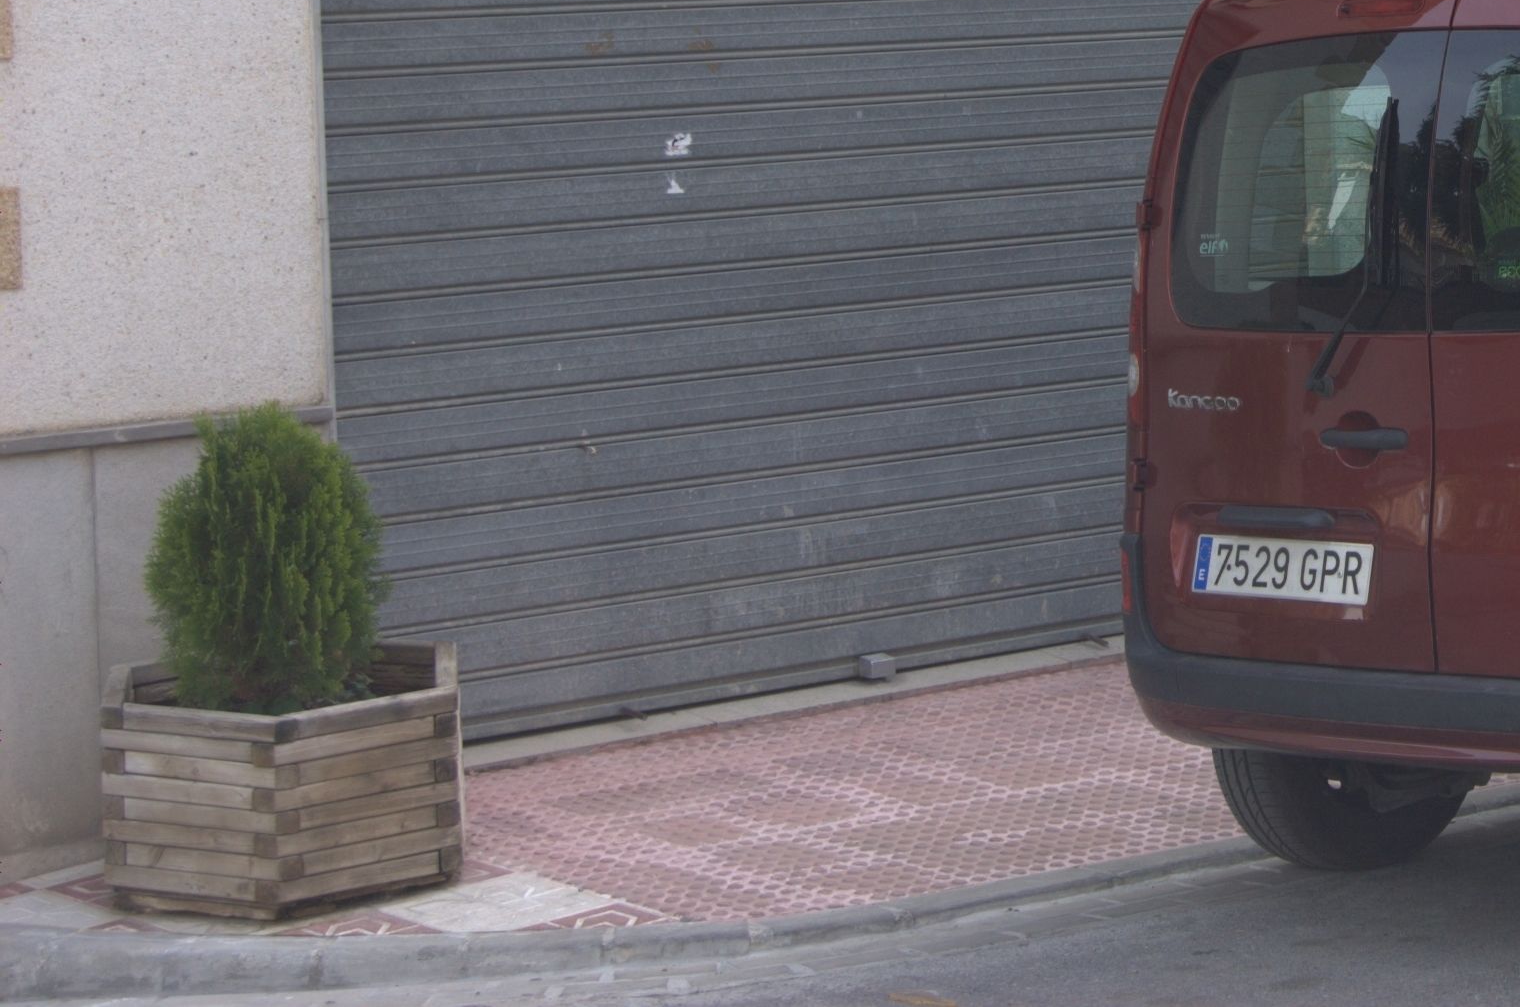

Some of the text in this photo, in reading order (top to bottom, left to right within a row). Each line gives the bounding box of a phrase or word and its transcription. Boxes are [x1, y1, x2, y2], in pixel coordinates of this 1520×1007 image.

[1198, 568, 1206, 581] E
[1213, 544, 1363, 595] 7529 GPR
